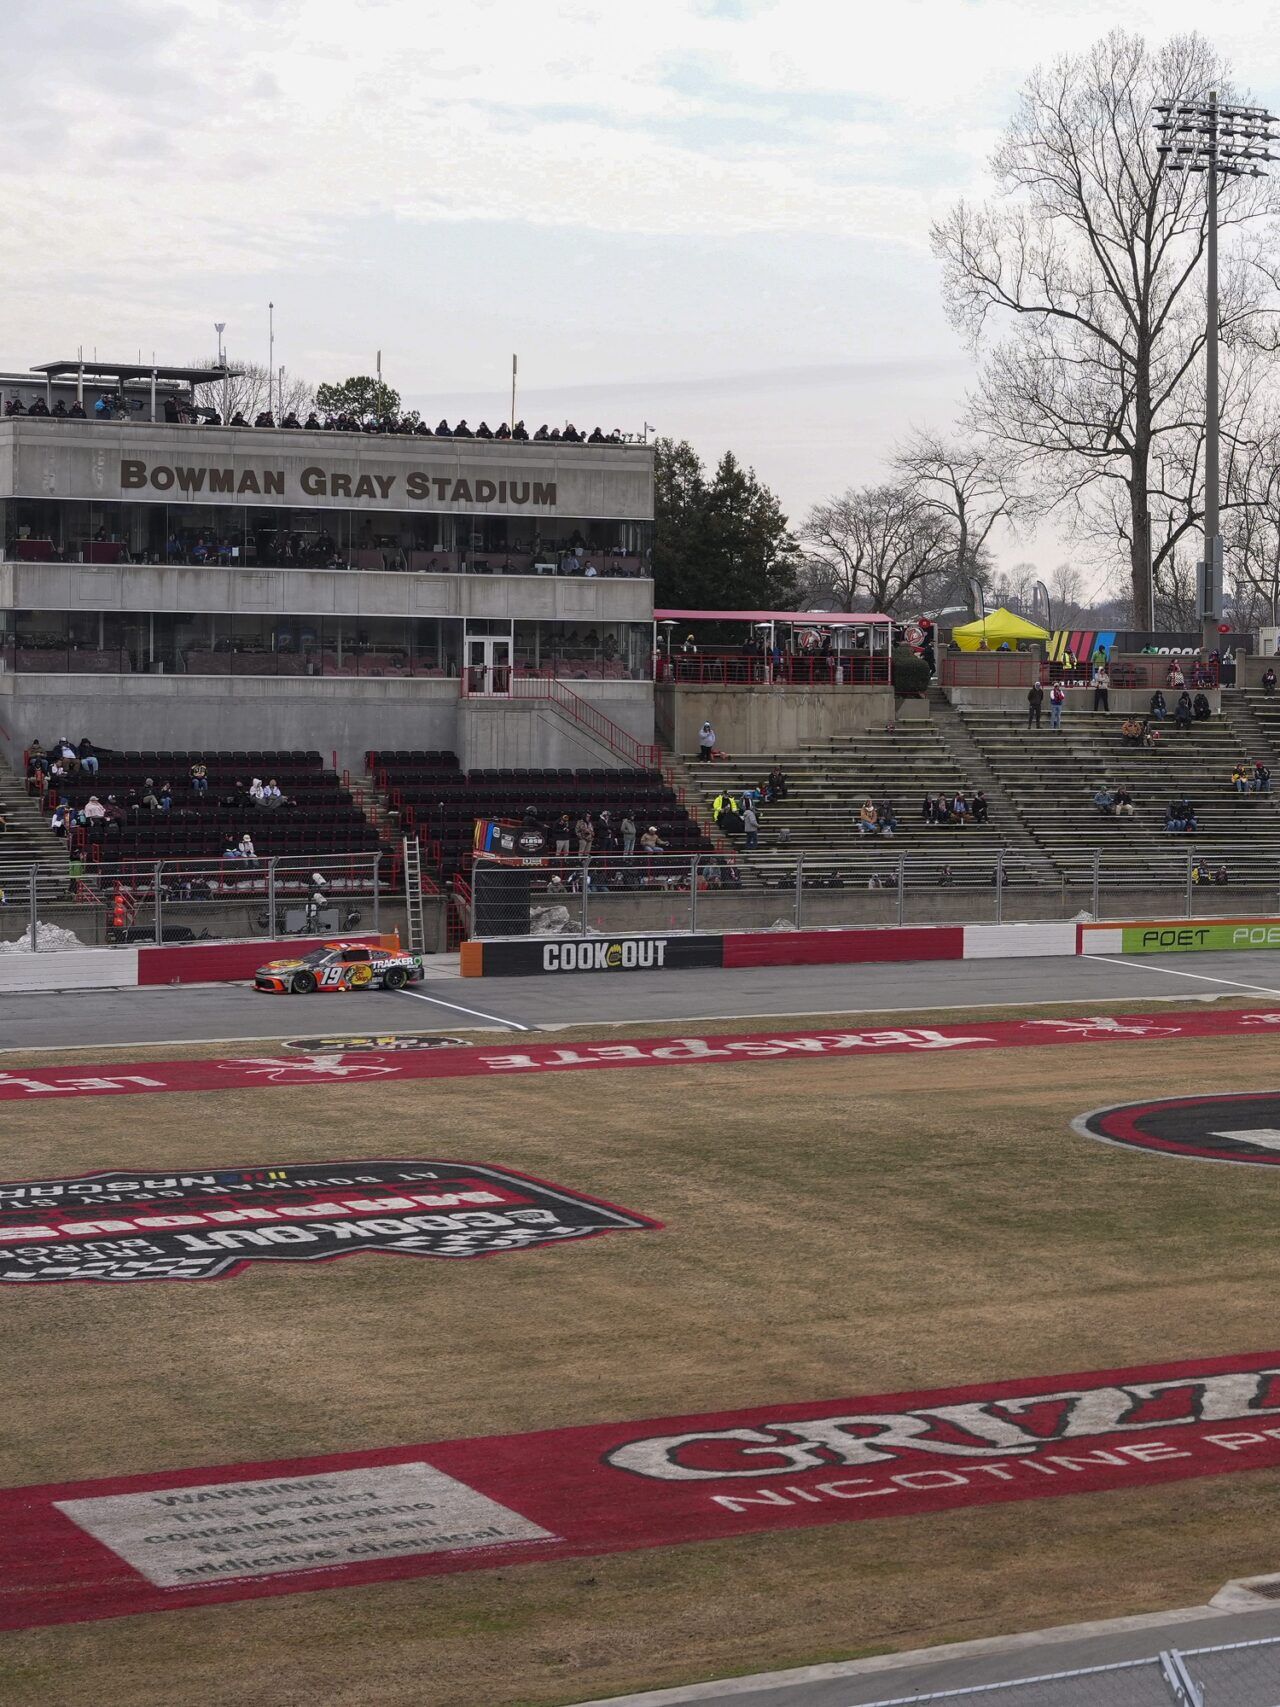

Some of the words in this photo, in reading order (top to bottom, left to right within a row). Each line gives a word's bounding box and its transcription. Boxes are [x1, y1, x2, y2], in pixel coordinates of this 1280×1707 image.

[120, 459, 285, 495] BOWMAN
[301, 466, 396, 499] GRAY
[406, 471, 557, 506] STADIUM
[1143, 930, 1210, 947] POET
[371, 957, 414, 968] TRACKER
[543, 942, 608, 971] COOK
[622, 940, 668, 968] OUT
[320, 967, 342, 985] 19
[484, 1039, 732, 1068] PETE
[725, 1029, 997, 1056] TEXAS
[0, 1176, 215, 1199] NASCAR
[200, 1176, 382, 1194] BOWMAN
[397, 1171, 439, 1181] AT
[79, 1190, 184, 1204] GRAY
[0, 1192, 506, 1241] MADHOUS
[0, 1238, 151, 1258] BURGE
[16, 1246, 166, 1265] FRESH
[711, 1442, 1194, 1513] NICOTINE
[153, 1480, 337, 1506] WARNING
[169, 1507, 245, 1524] This
[250, 1491, 380, 1517] product
[144, 1517, 294, 1545] contains
[197, 1529, 350, 1555] Nicotine
[355, 1520, 388, 1534] is
[398, 1517, 437, 1531] an
[173, 1547, 338, 1578] addictive
[347, 1526, 516, 1555] chemical.
